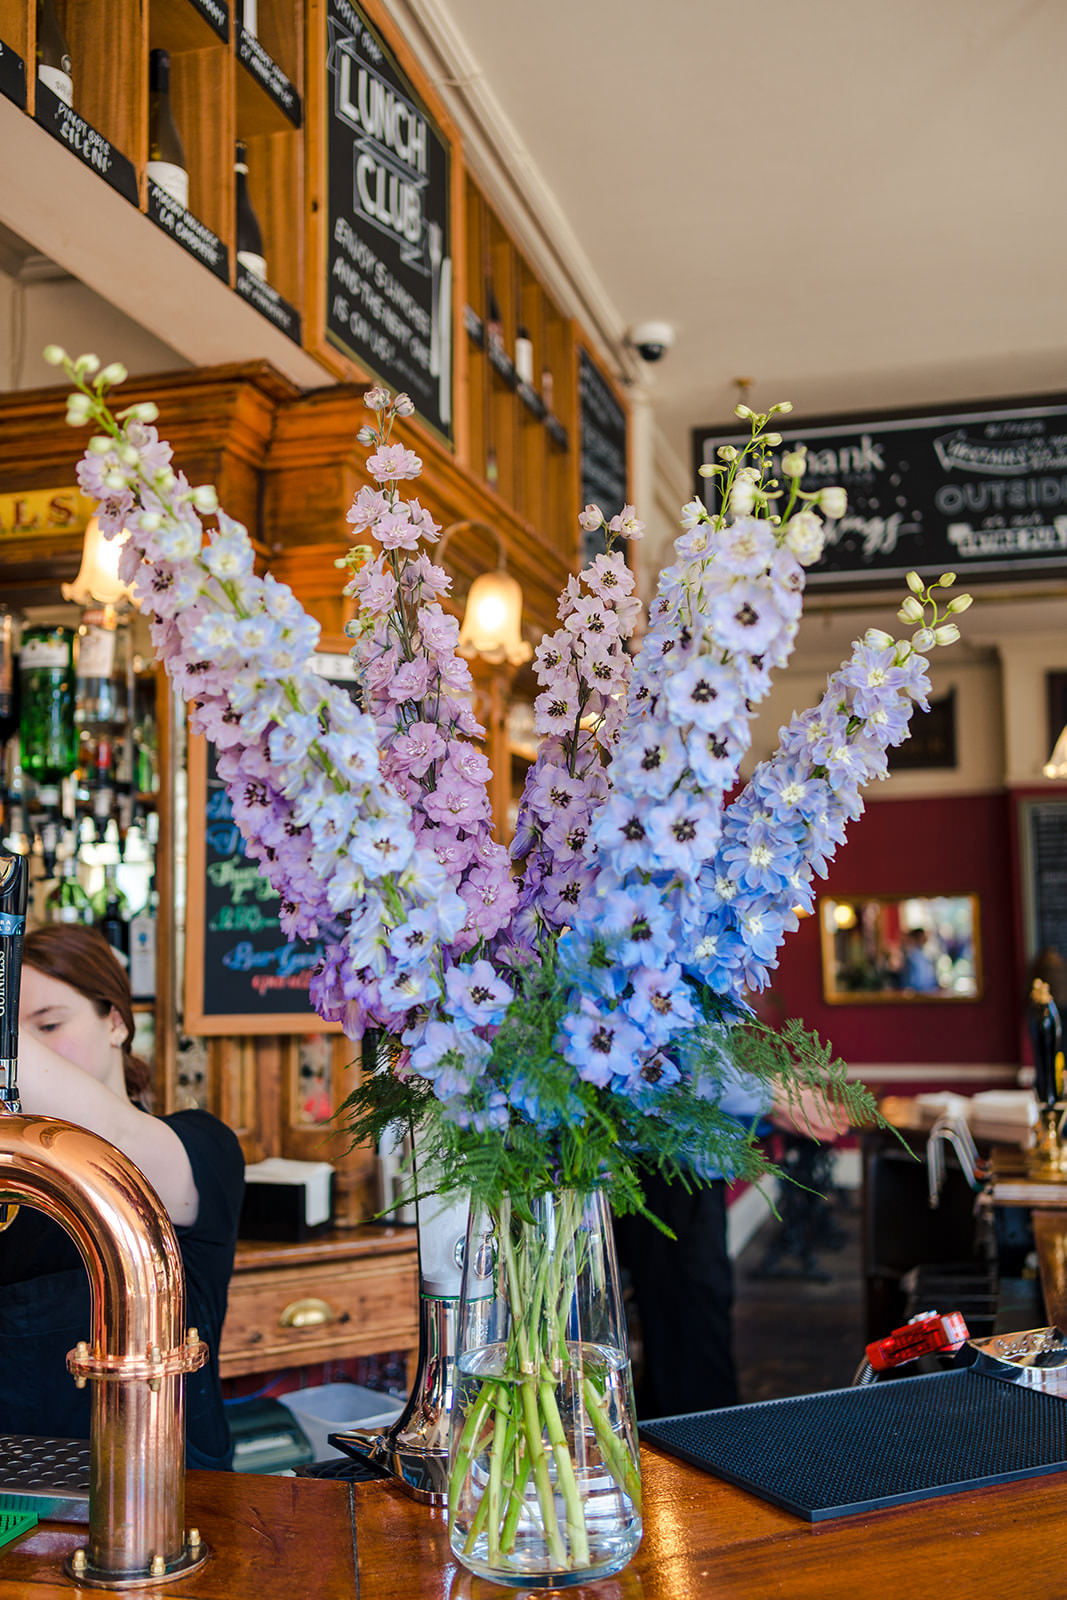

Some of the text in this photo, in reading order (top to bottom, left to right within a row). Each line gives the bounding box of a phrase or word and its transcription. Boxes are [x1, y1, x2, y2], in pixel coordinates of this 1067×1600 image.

[58, 102, 87, 137] PINOT
[339, 53, 427, 175] LUNCH
[356, 152, 422, 243] CLUB
[332, 256, 361, 295] AND
